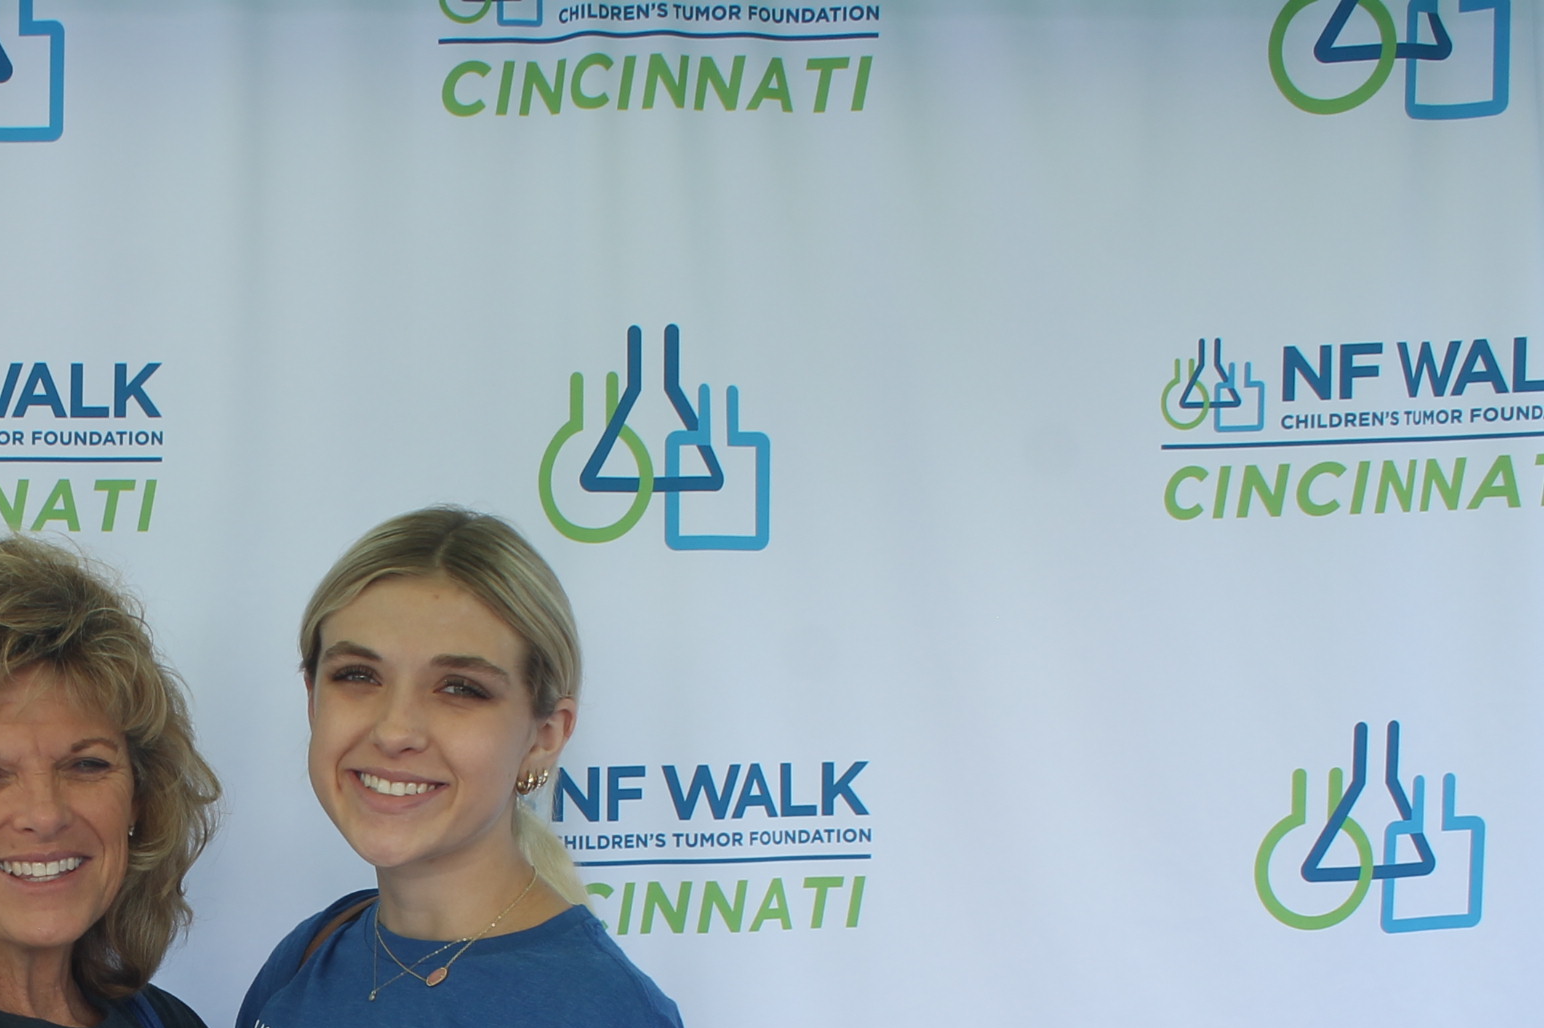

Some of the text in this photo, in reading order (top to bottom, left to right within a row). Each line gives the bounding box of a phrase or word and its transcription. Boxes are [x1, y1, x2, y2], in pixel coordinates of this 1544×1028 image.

[558, 3, 880, 24] CHILDREN'S TUMOR FOUNDATION
[441, 52, 873, 117] CINCINNATI
[1282, 336, 1544, 402] NF WAL
[31, 430, 164, 446] FOUNDATION
[1280, 404, 1544, 430] CHILDREN'S TUMOR FOUND
[1163, 453, 1544, 520] CINCINNA
[551, 760, 870, 822] NF WALK
[561, 828, 872, 850] HILDREN'S TUMOR FOUNDATION
